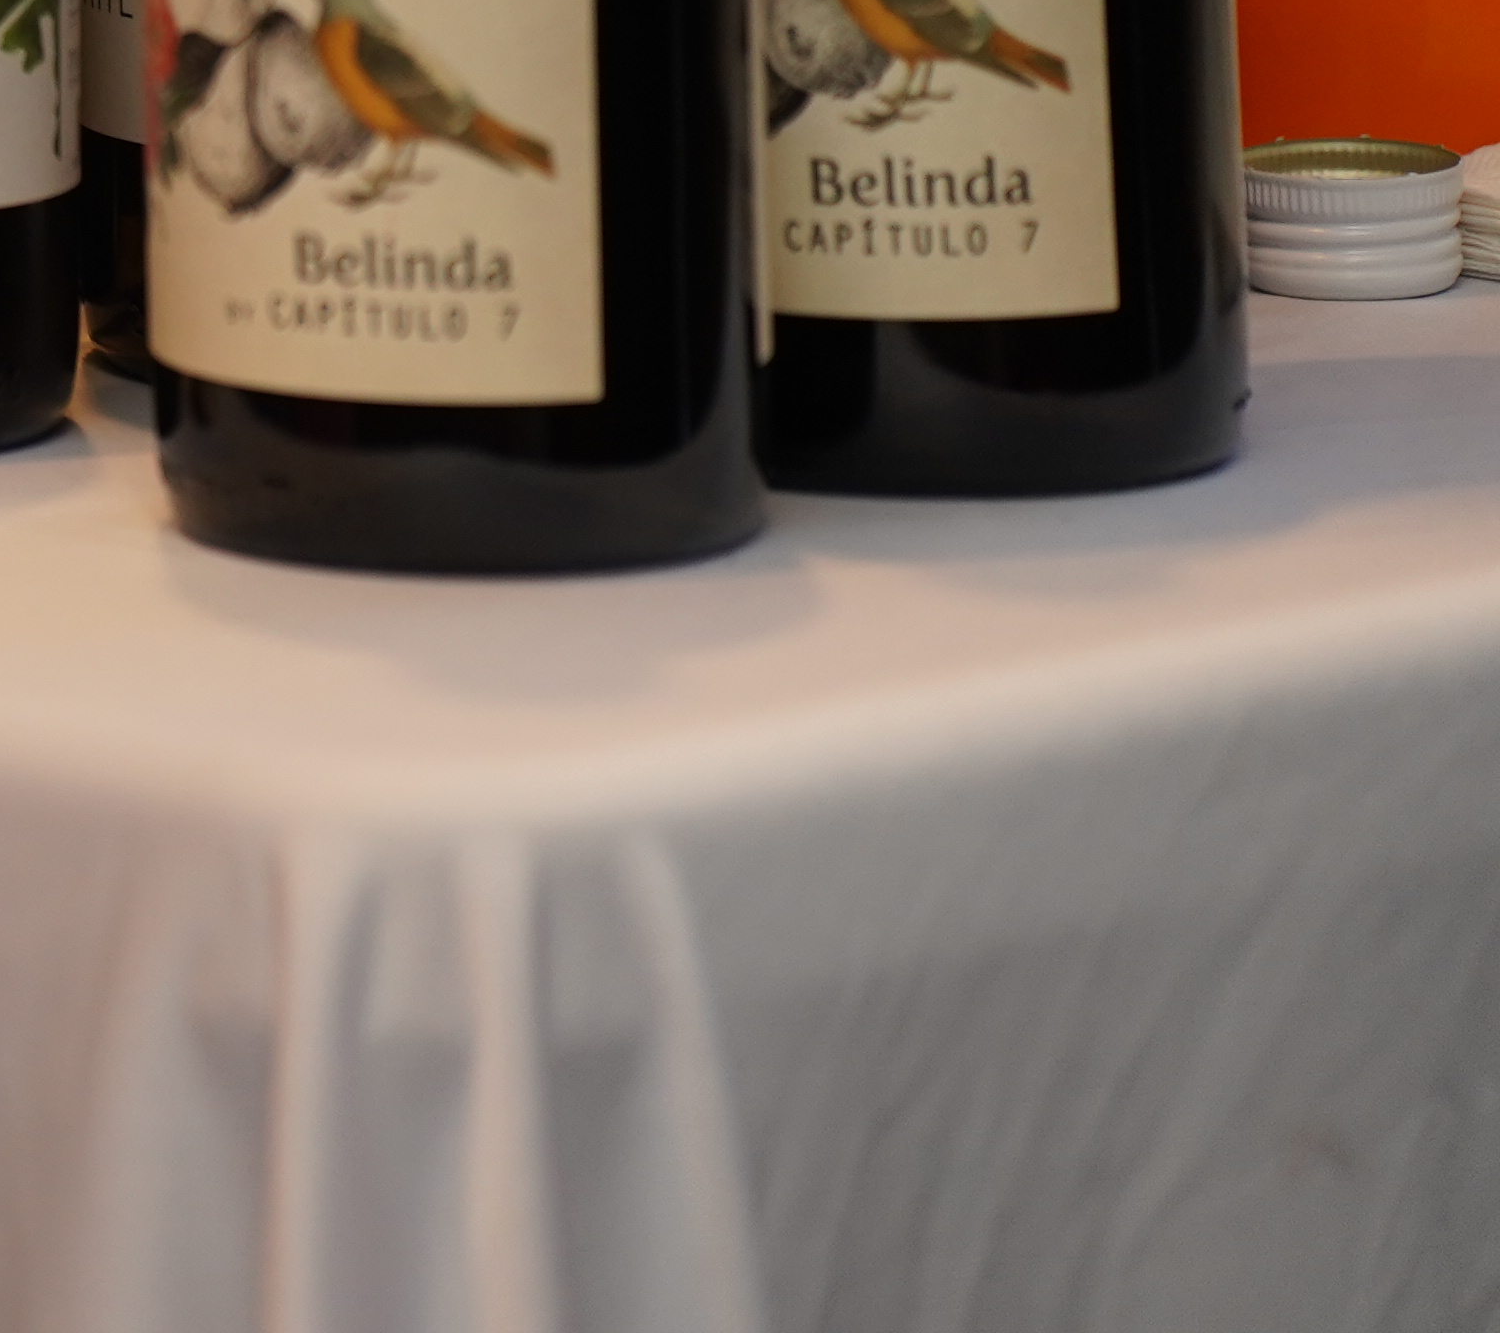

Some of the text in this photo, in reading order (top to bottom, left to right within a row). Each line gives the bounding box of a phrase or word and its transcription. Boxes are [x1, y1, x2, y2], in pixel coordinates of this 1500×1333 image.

[809, 155, 1032, 207] Belinda
[293, 229, 513, 291] Belinda
[782, 217, 1040, 257] CAPÍTULO 7
[501, 302, 522, 341] 7
